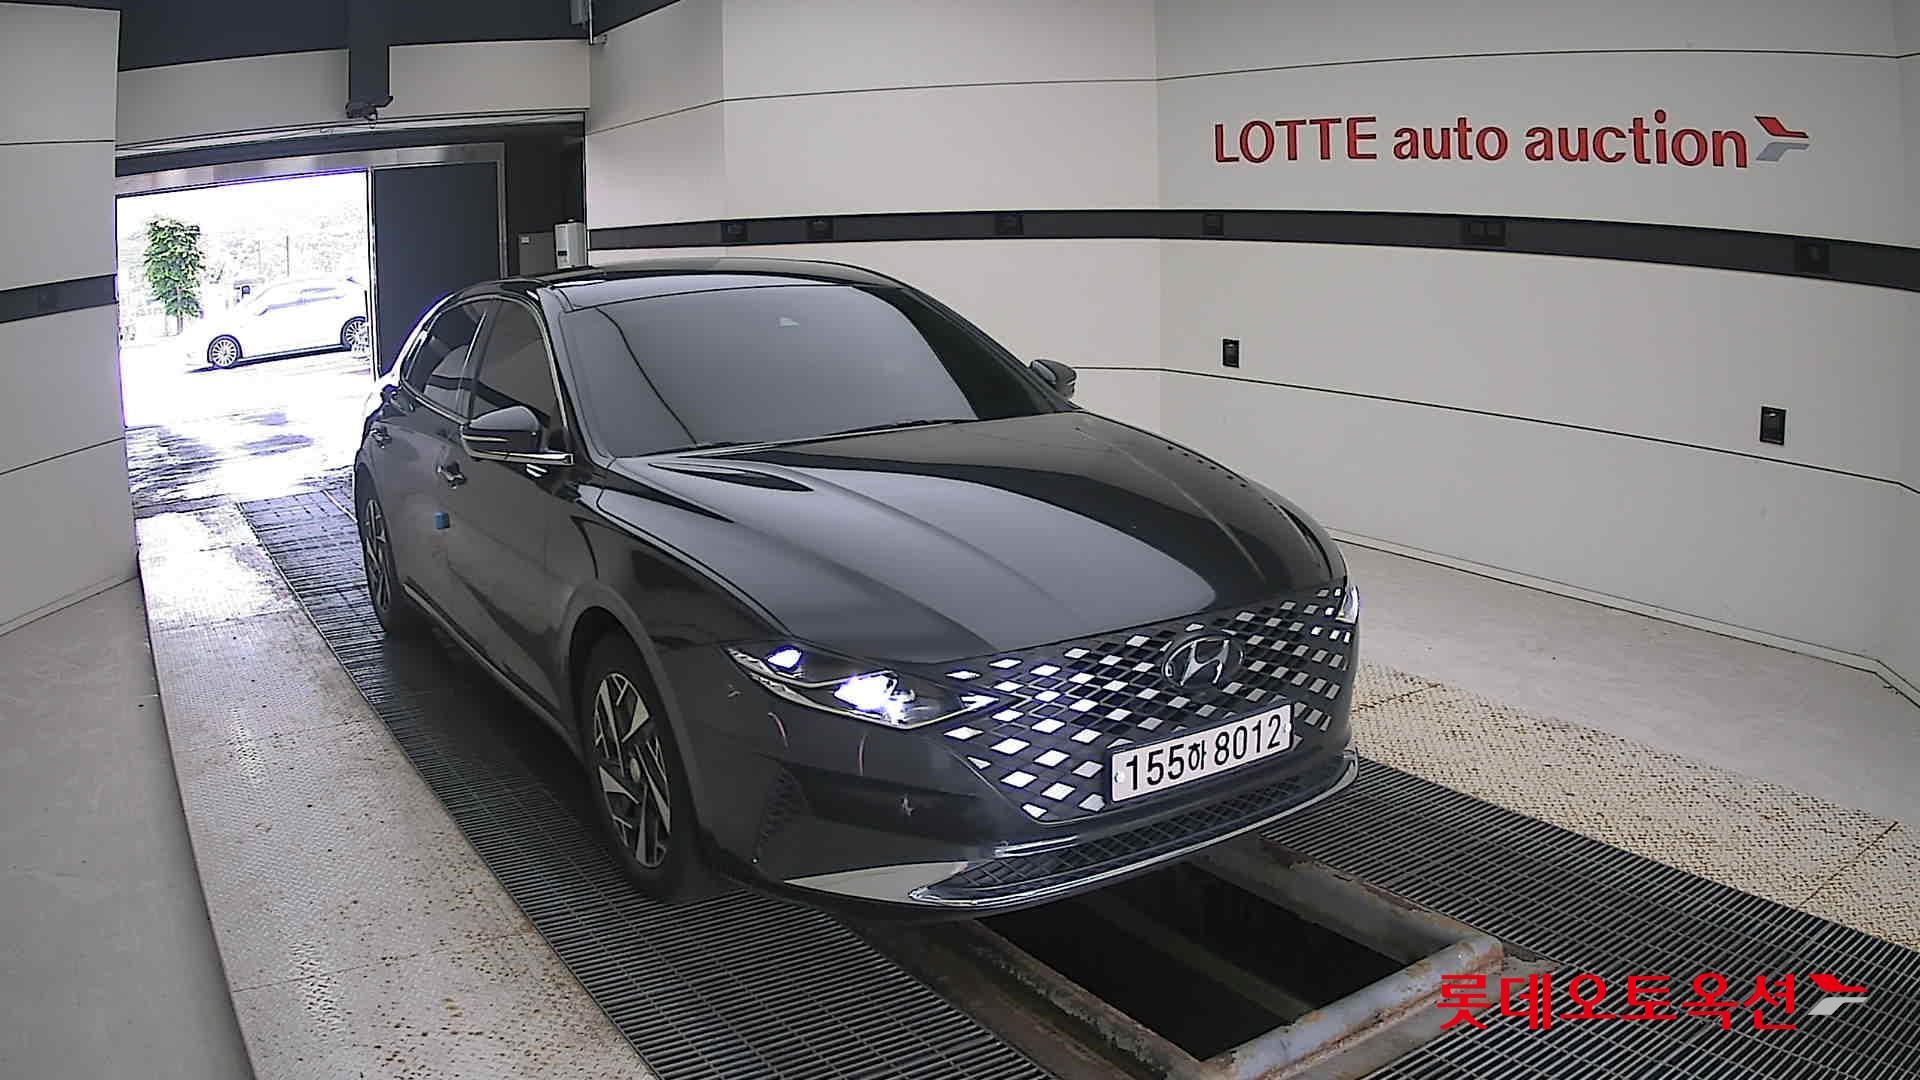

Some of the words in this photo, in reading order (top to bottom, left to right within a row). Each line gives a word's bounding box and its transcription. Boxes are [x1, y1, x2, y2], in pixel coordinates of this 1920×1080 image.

[1214, 116, 1378, 164] LOTTE
[1392, 116, 1509, 162] auto
[1524, 109, 1748, 169] auction
[1126, 740, 1207, 790] 155하
[1214, 714, 1282, 766] 8012
